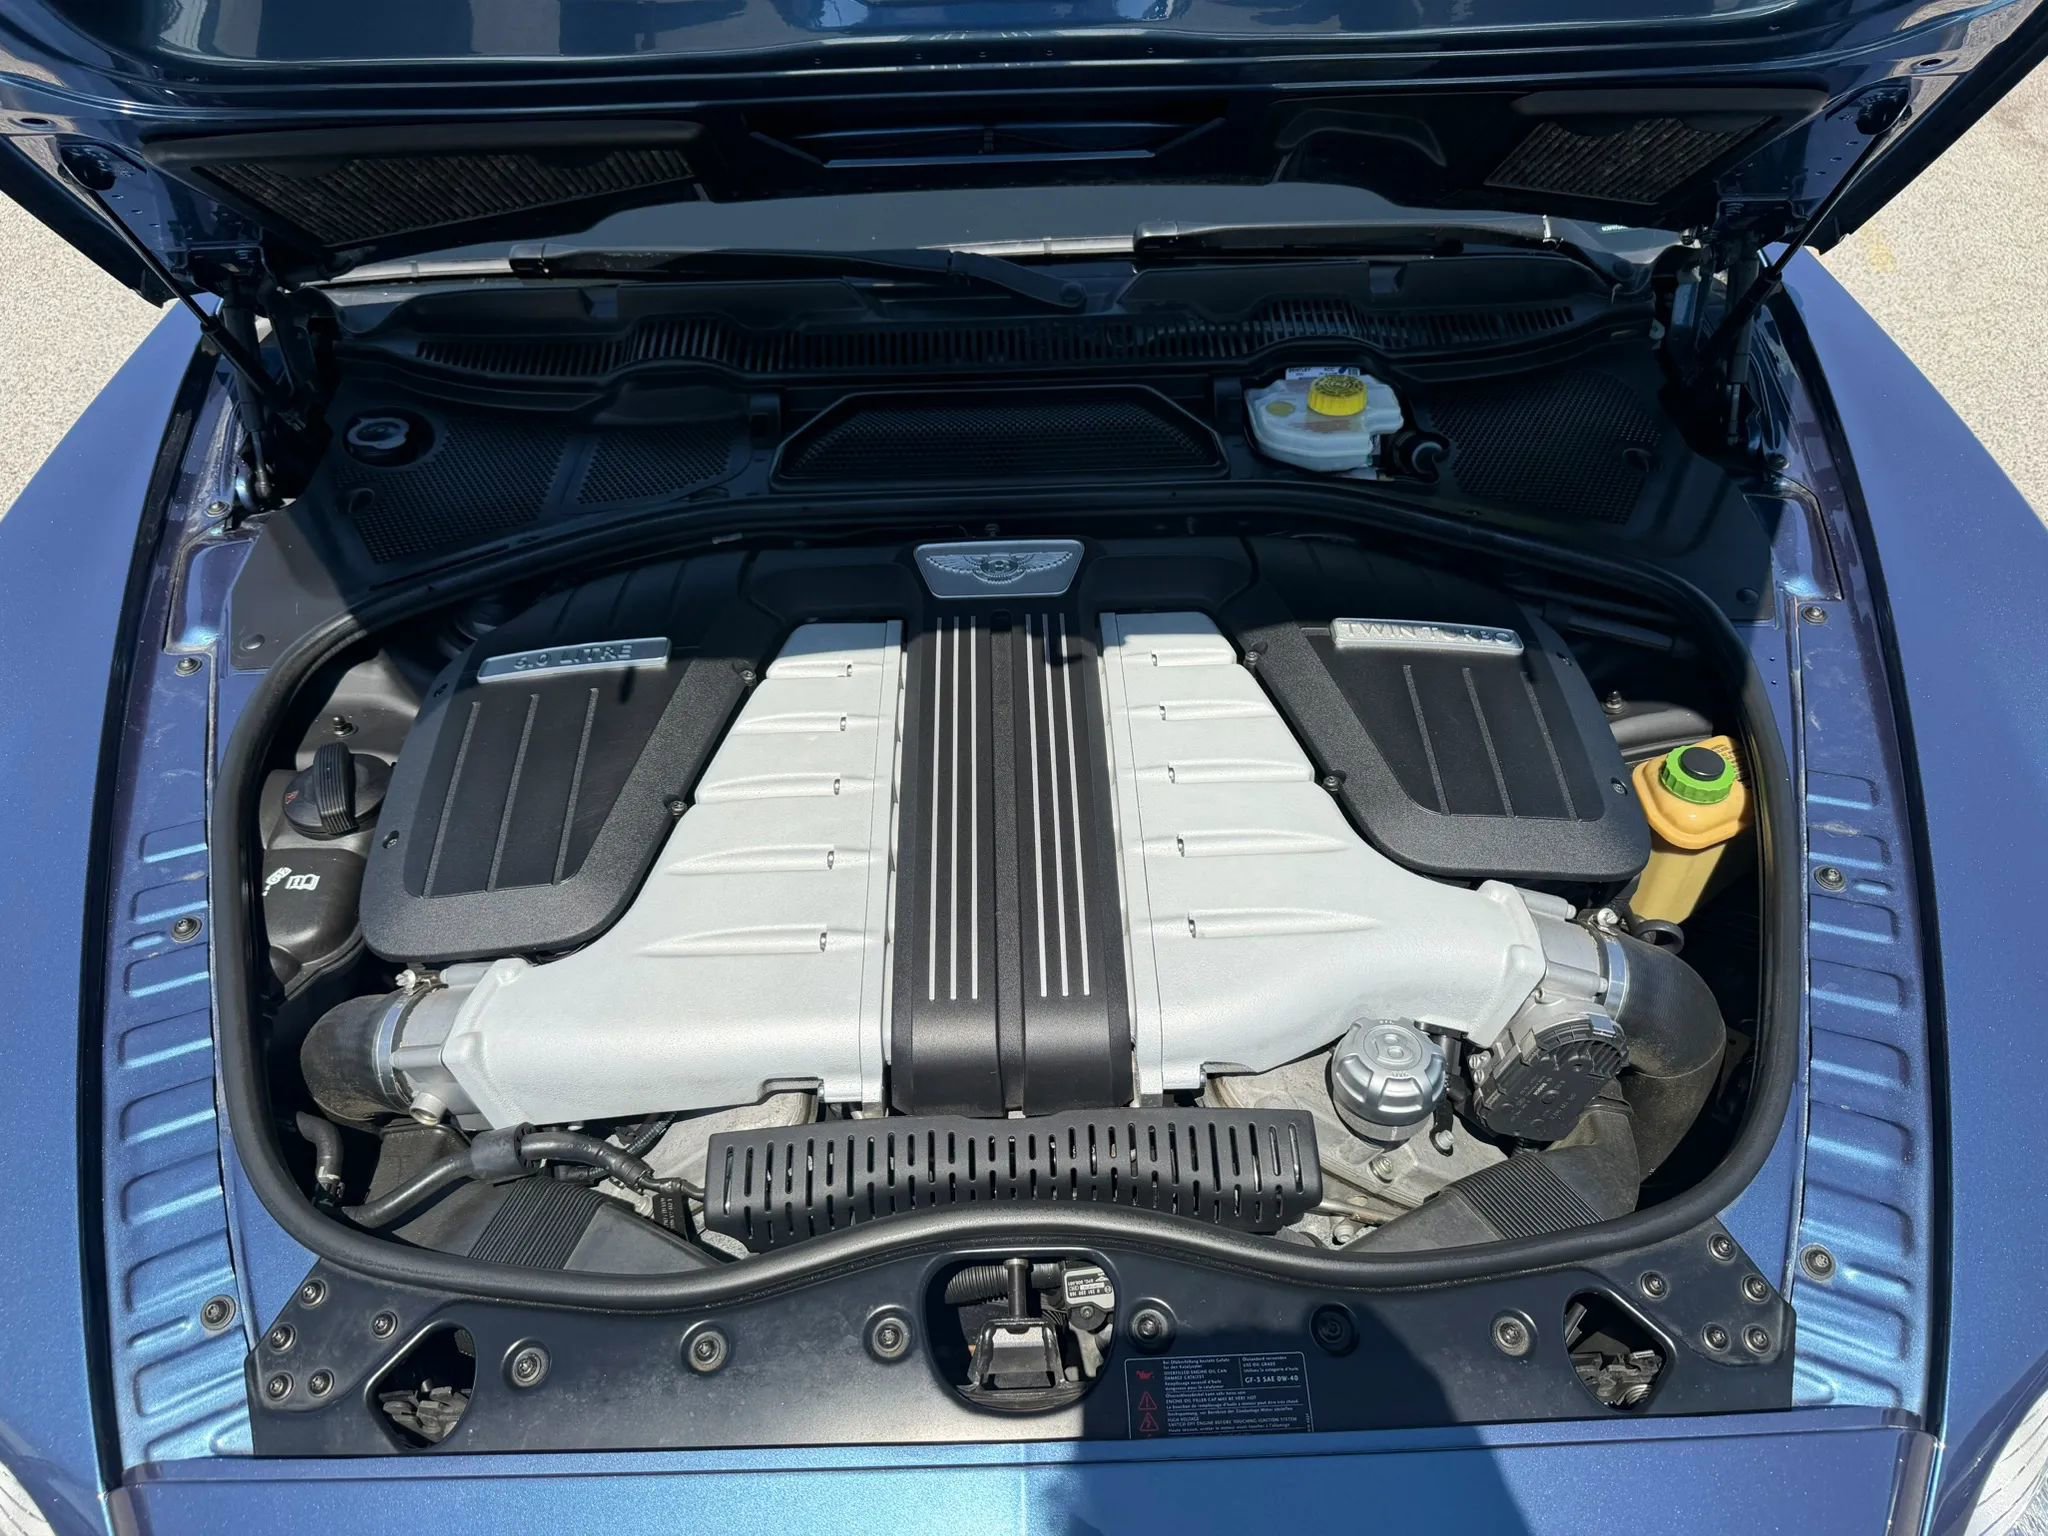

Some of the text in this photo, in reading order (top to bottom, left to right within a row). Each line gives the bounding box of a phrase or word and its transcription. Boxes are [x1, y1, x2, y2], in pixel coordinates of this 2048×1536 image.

[1341, 622, 1515, 644] TWIN TURBO
[558, 643, 634, 664] LITRE
[1276, 1374, 1299, 1382] 0W-40
